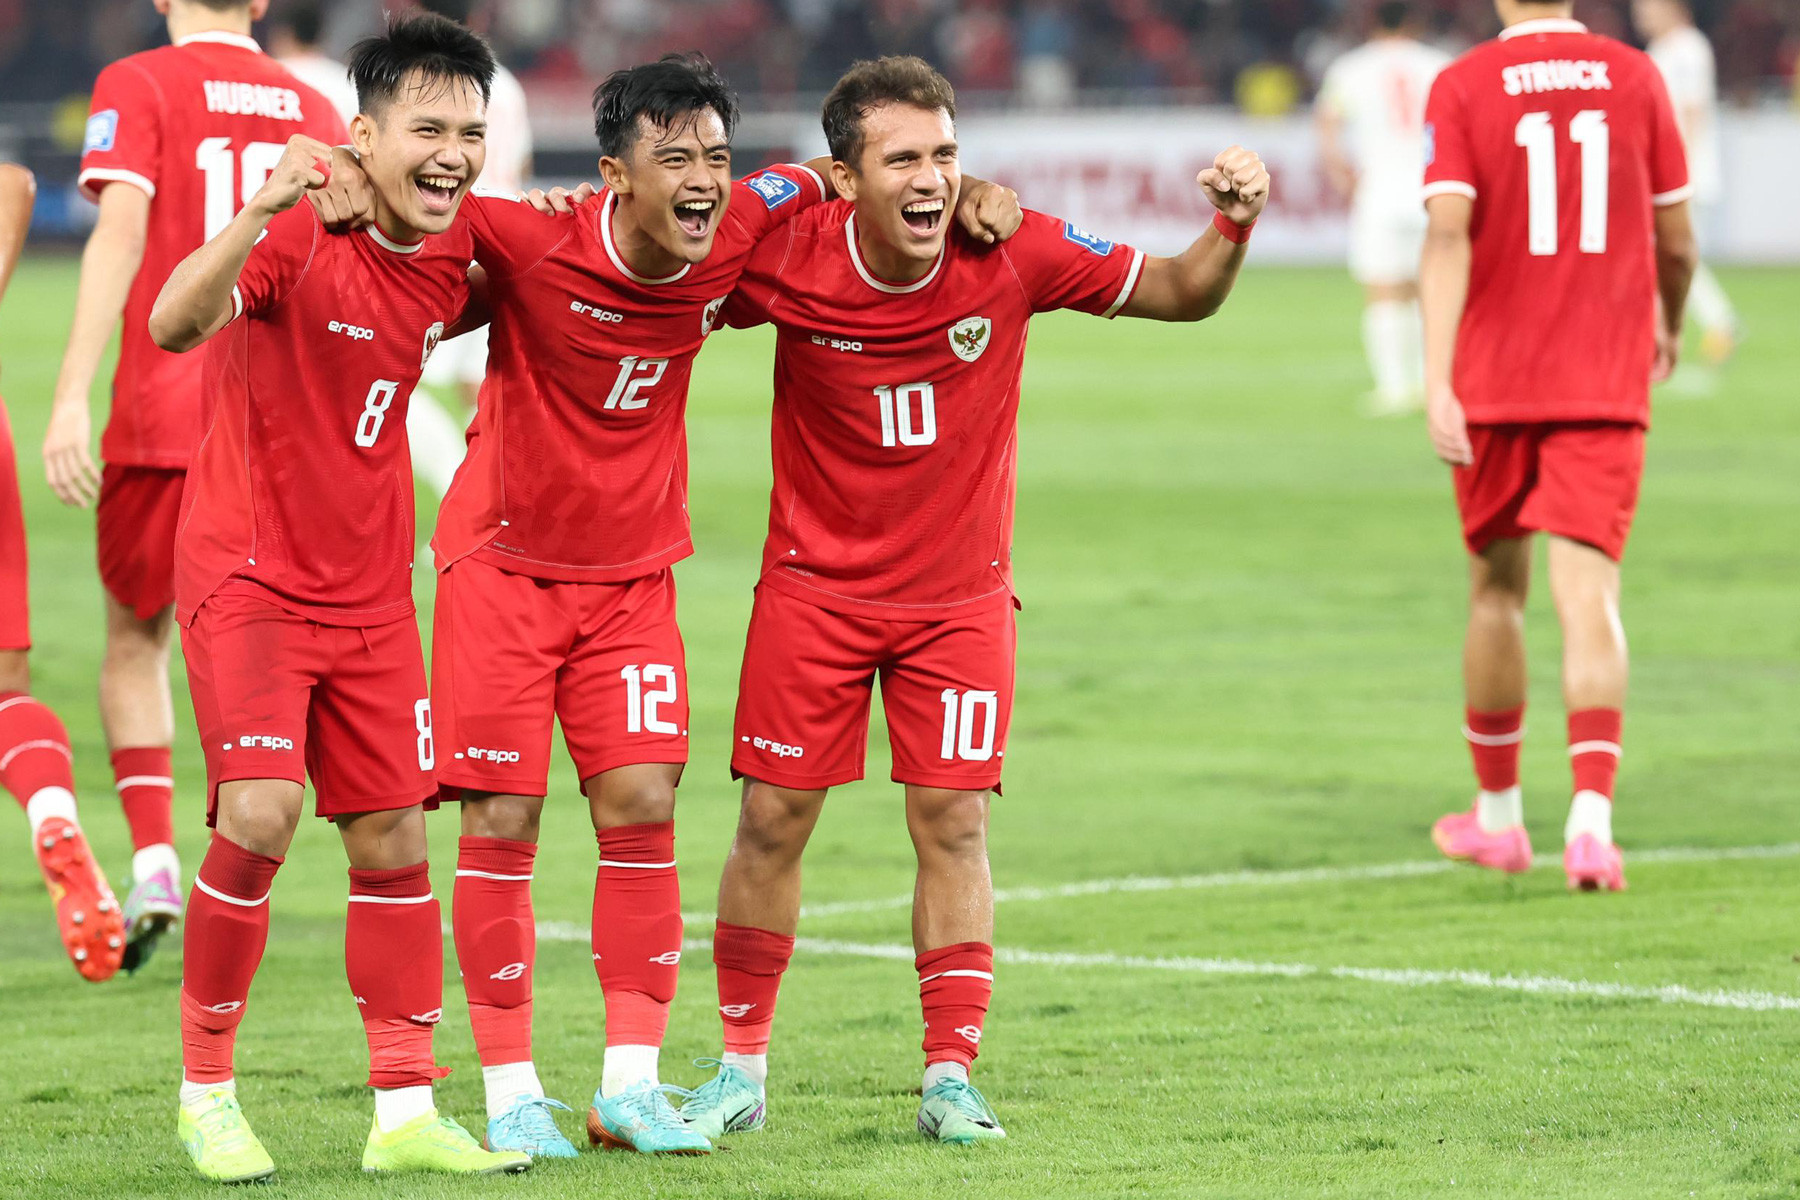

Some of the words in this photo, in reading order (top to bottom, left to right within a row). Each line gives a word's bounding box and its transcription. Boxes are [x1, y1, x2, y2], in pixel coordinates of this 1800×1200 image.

[1501, 60, 1612, 97] STRUICK
[202, 80, 304, 122] HUBNER
[1514, 110, 1609, 256] 11
[327, 320, 374, 341] erspo
[570, 301, 623, 323] erspo
[811, 334, 863, 353] erspo
[603, 355, 669, 410] 12
[354, 378, 399, 448] 8
[872, 382, 936, 447] 10
[620, 663, 679, 735] 12
[239, 735, 294, 751] erspo
[414, 697, 435, 771] 8
[940, 688, 998, 762] 10
[467, 747, 520, 764] erspo
[752, 736, 804, 758] erspo
